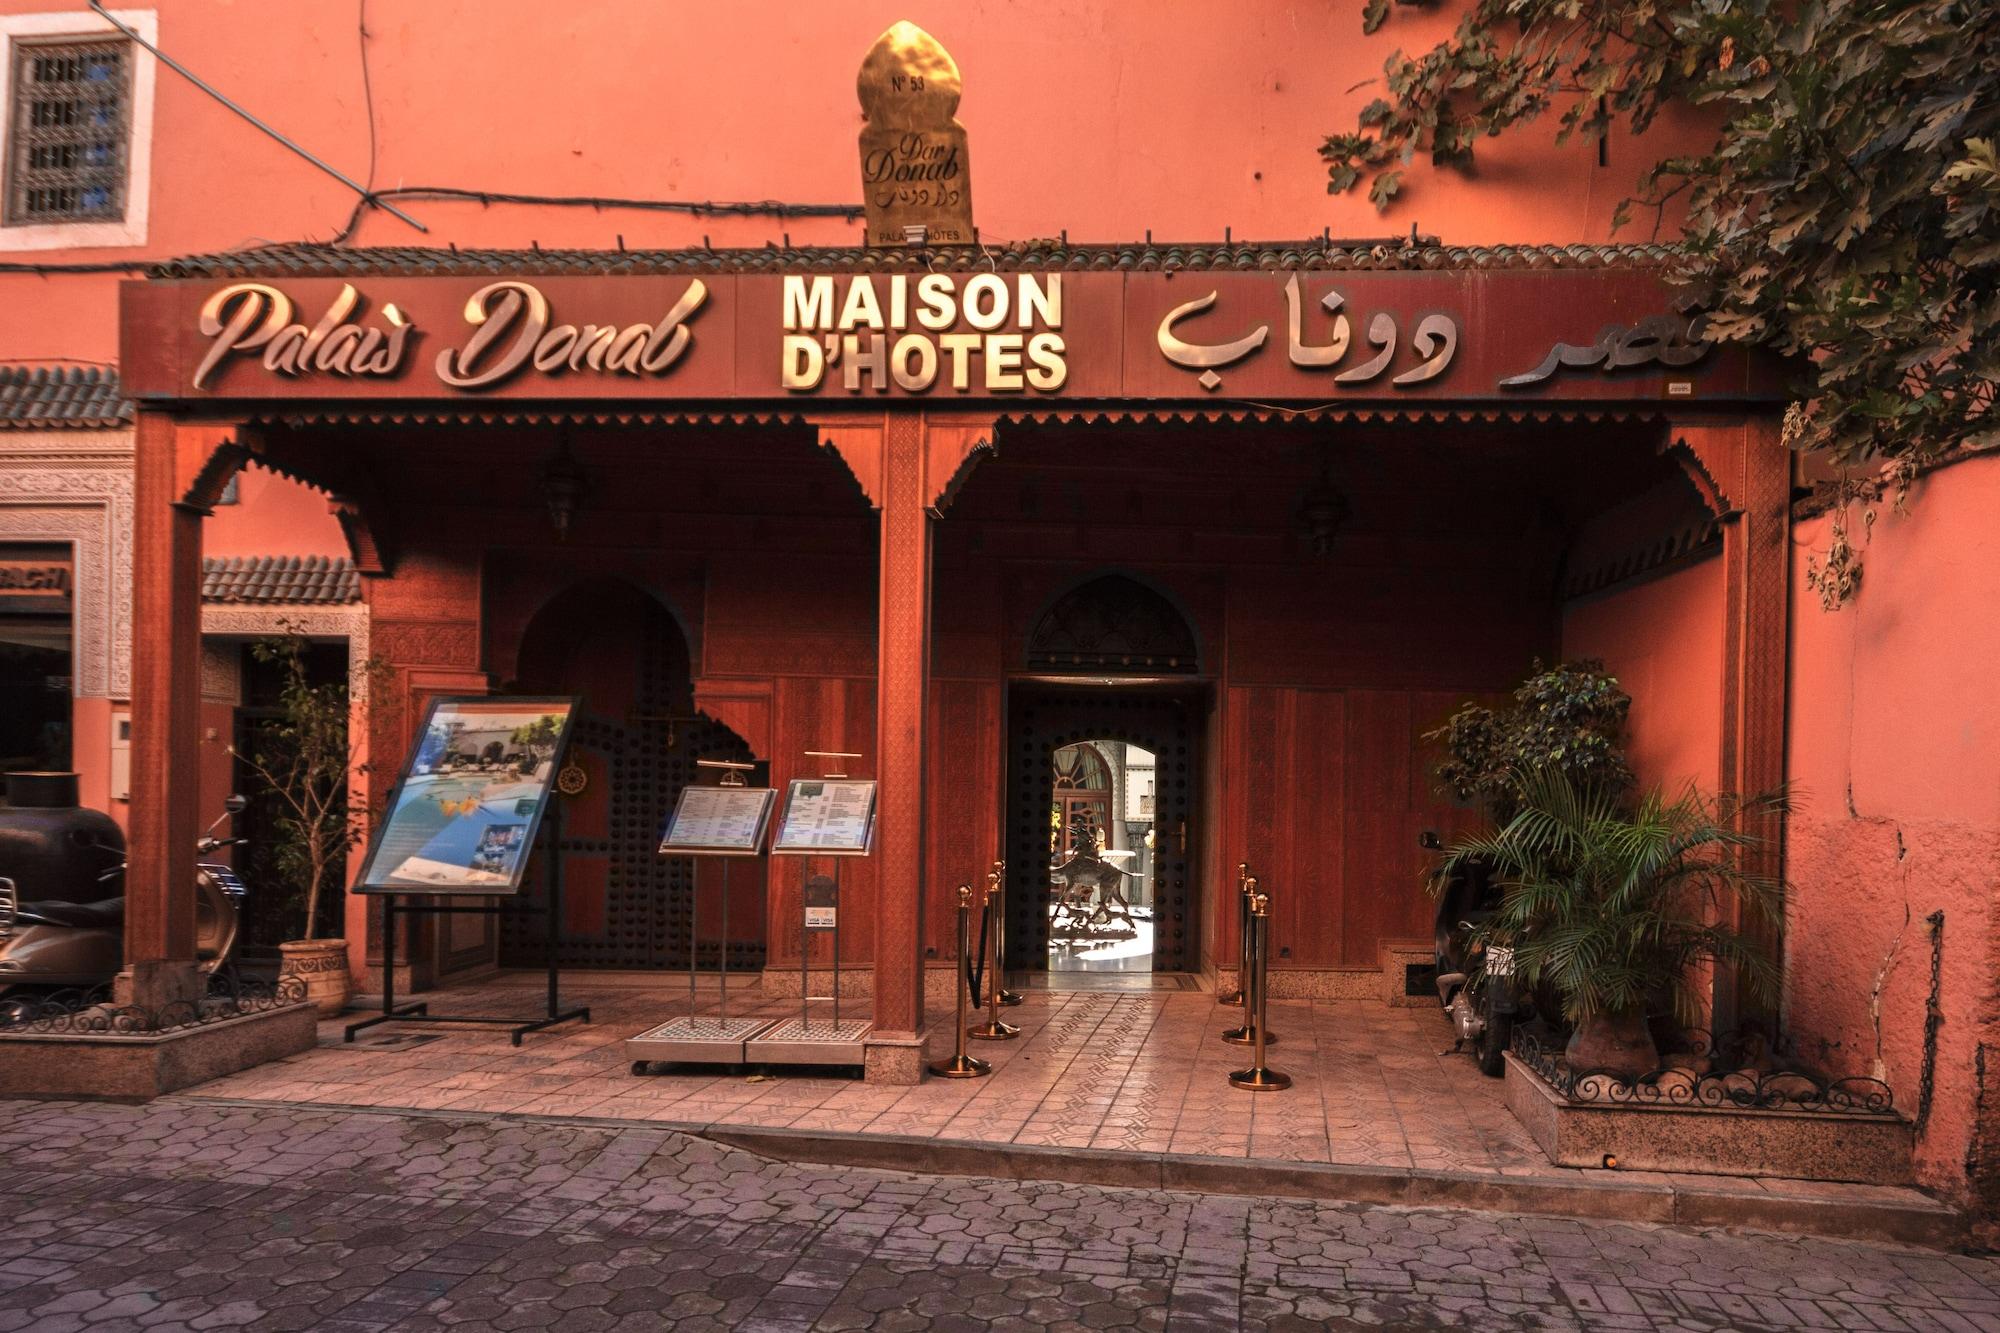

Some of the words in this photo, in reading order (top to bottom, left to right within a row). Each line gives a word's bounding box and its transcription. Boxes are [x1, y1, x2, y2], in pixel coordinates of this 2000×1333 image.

[910, 75, 925, 92] 53
[864, 145, 958, 183] Donab
[900, 132, 945, 161] Dar
[783, 273, 1062, 331] MAISON
[193, 283, 415, 390] Palais
[435, 278, 708, 388] Donab
[782, 333, 1067, 391] D'HOTES
